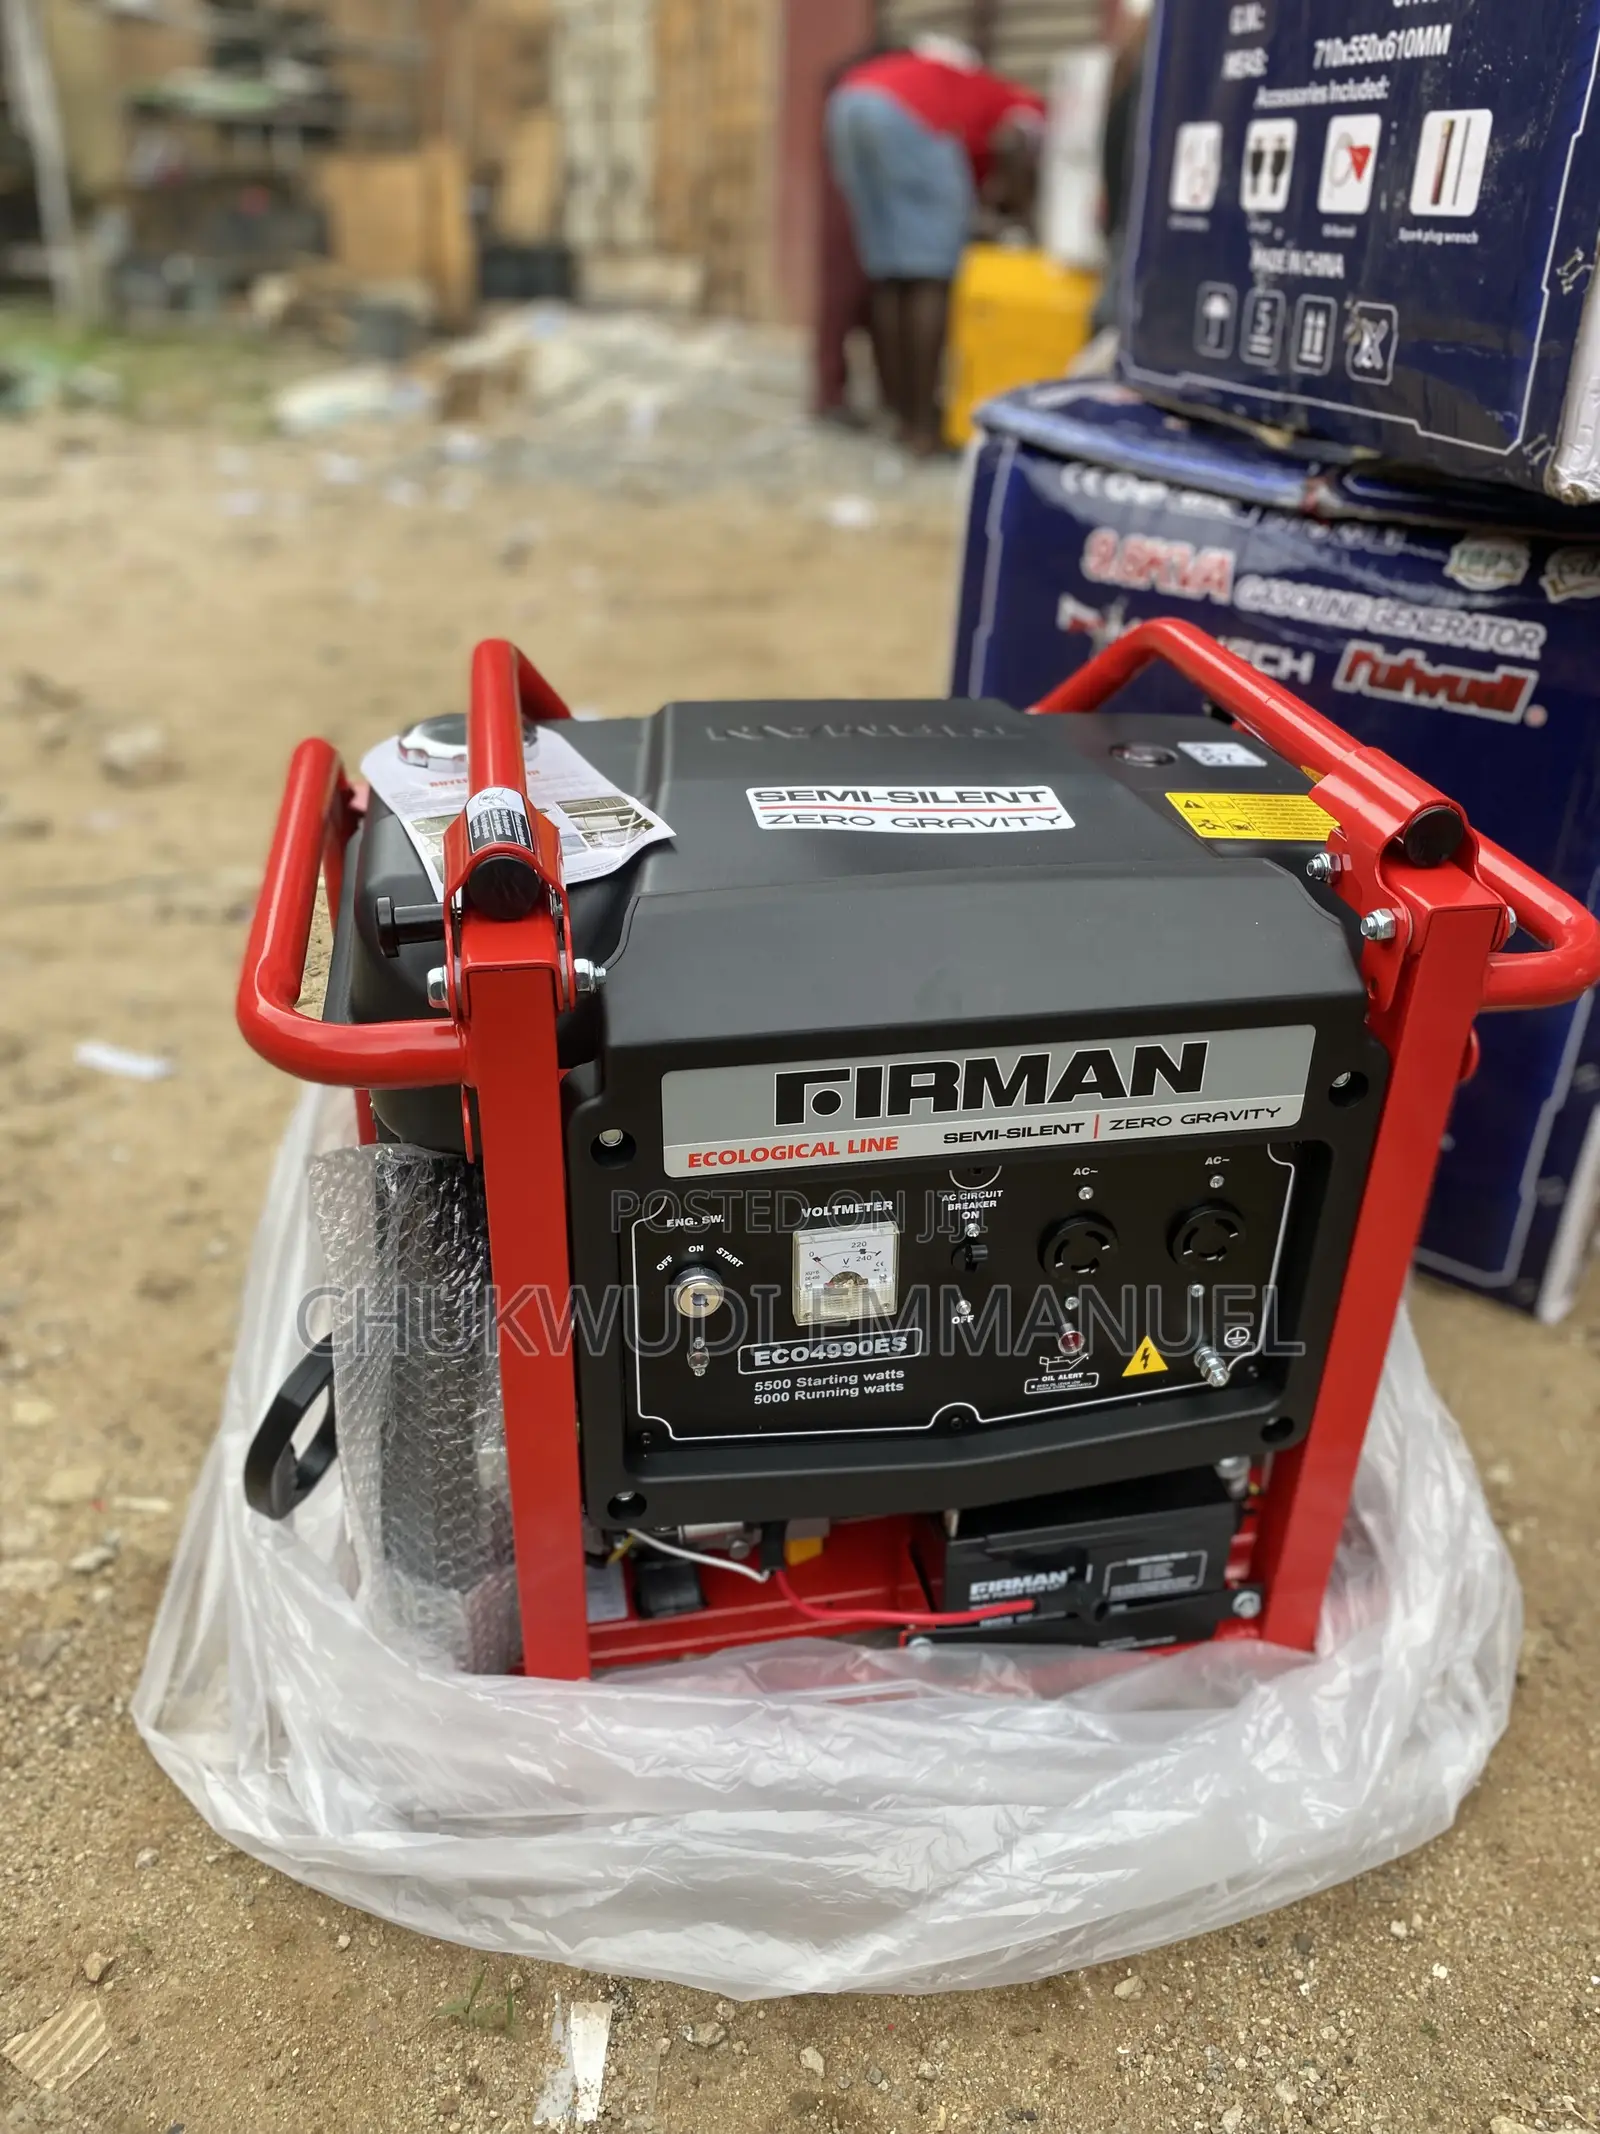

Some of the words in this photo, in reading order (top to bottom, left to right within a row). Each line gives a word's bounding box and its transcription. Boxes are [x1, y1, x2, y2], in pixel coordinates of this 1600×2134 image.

[1312, 23, 1452, 70] 710x550x610MM
[1253, 82, 1327, 109] Accessories
[1330, 74, 1390, 103] Included:
[1444, 230, 1479, 244] wrench
[1250, 248, 1288, 274] MADE
[1301, 251, 1345, 279] CHINA
[1367, 597, 1547, 660] GENERATOR
[752, 789, 1048, 804] SEMI-SILENT
[763, 813, 875, 826] ZERO
[891, 814, 1063, 829] GRAVITY
[773, 1040, 1210, 1127] FIRMAN
[943, 1122, 1085, 1144] SEMI-SILENT
[1109, 1115, 1172, 1131] ZERO
[1180, 1107, 1282, 1125] GRAVITY
[688, 1141, 840, 1168] ECOLOGICAL
[848, 1136, 899, 1154] LINE
[942, 1194, 957, 1202] AC
[960, 1190, 1003, 1200] CIRCUIT
[801, 1200, 893, 1218] VOLTMETER
[948, 1200, 997, 1211] BREAKER
[666, 1218, 698, 1228] ENG.
[702, 1214, 725, 1225] SW.
[961, 1211, 980, 1220] ON
[688, 1244, 704, 1253] ON
[851, 1241, 867, 1249] 220
[656, 1255, 673, 1271] OFF
[716, 1247, 744, 1268] START
[842, 1258, 850, 1266] V
[856, 1254, 872, 1262] 240
[951, 1315, 975, 1324] OFF
[754, 1336, 908, 1366] ECO4990ES
[754, 1379, 791, 1391] 5500
[796, 1373, 858, 1387] Starting
[863, 1369, 905, 1382] watts
[1058, 1372, 1084, 1380] ALERT
[754, 1391, 790, 1404] 5000
[795, 1386, 859, 1400] Running
[864, 1382, 904, 1394] watts
[969, 1568, 1069, 1596] FIRMAN
